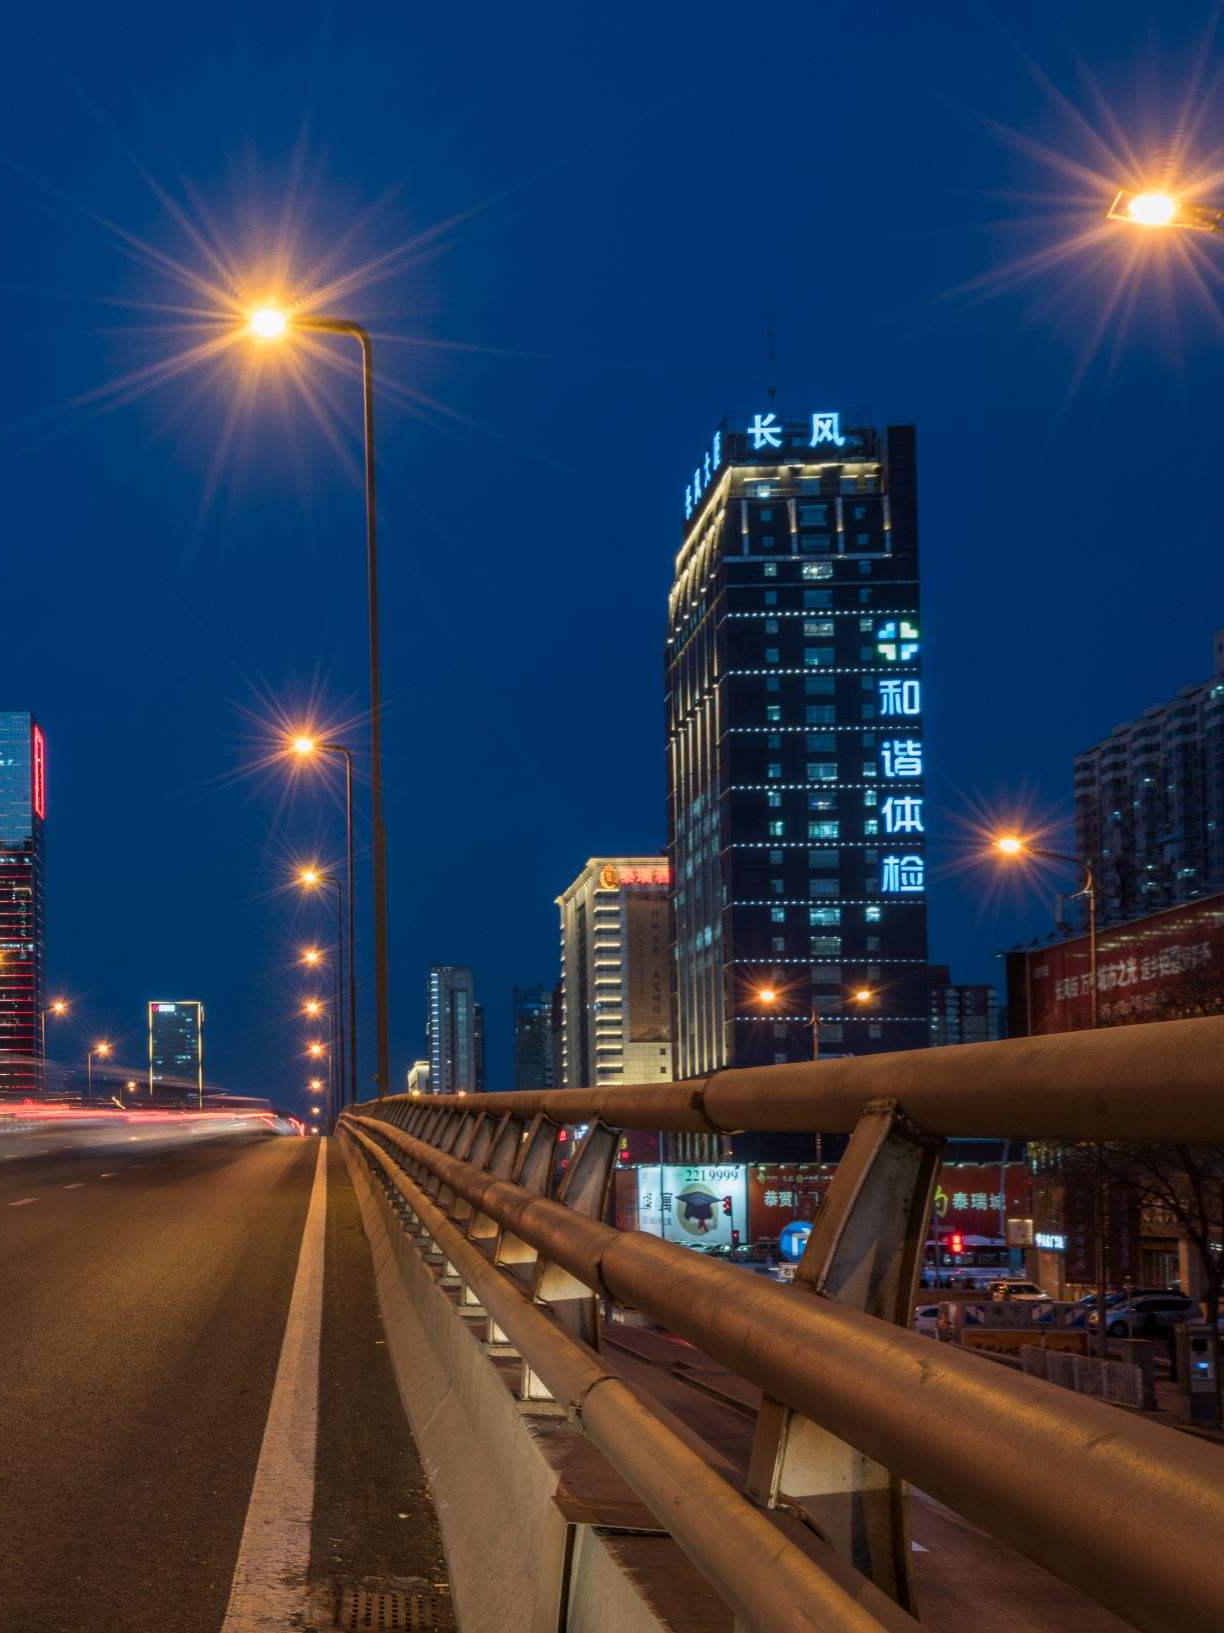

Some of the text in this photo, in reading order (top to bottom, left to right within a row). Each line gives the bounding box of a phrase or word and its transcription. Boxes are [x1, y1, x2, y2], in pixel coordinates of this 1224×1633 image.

[747, 412, 846, 450] 长风
[879, 679, 925, 893] 和谐体检
[685, 1169, 739, 1182] 2219999
